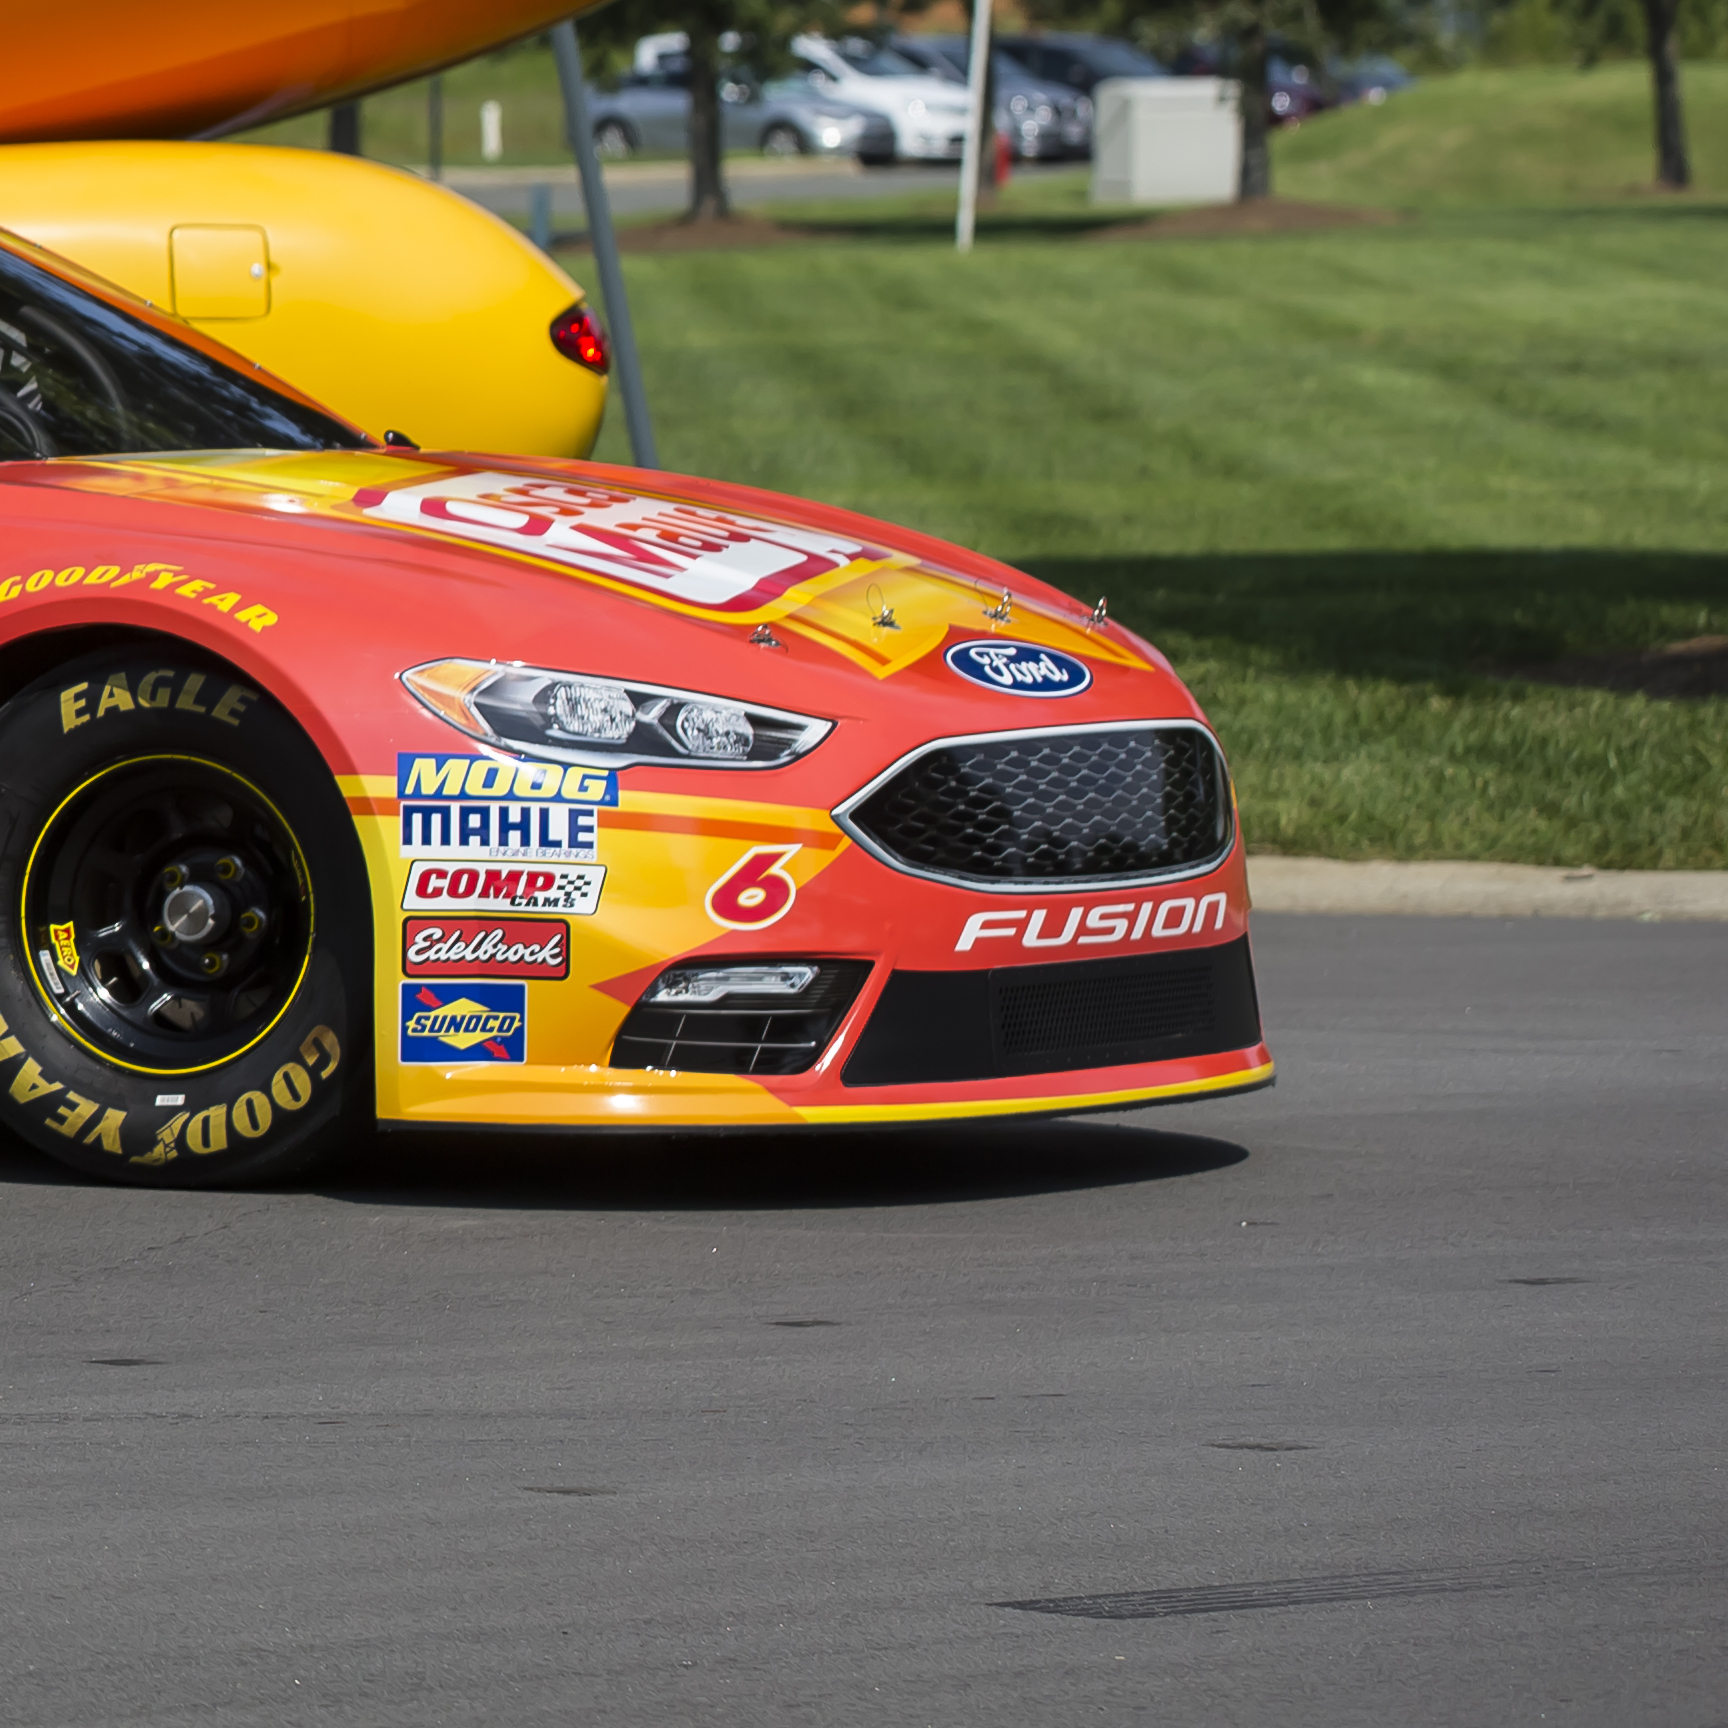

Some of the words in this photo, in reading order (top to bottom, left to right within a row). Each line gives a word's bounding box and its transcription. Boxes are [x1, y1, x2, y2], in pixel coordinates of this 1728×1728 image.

[968, 646, 1070, 686] Ford
[59, 668, 259, 735] EAGLE
[403, 757, 610, 802] MOOG
[401, 804, 595, 850] MAHLE
[488, 847, 534, 858] ENGINE
[535, 848, 595, 860] BEARINGS
[414, 867, 557, 900] COMP
[509, 894, 577, 909] CAMS
[704, 842, 803, 931] 6
[952, 890, 1230, 954] FUSION
[56, 929, 76, 966] AERO
[406, 926, 566, 967] Edelbrock
[410, 1013, 518, 1035] SUNOCO
